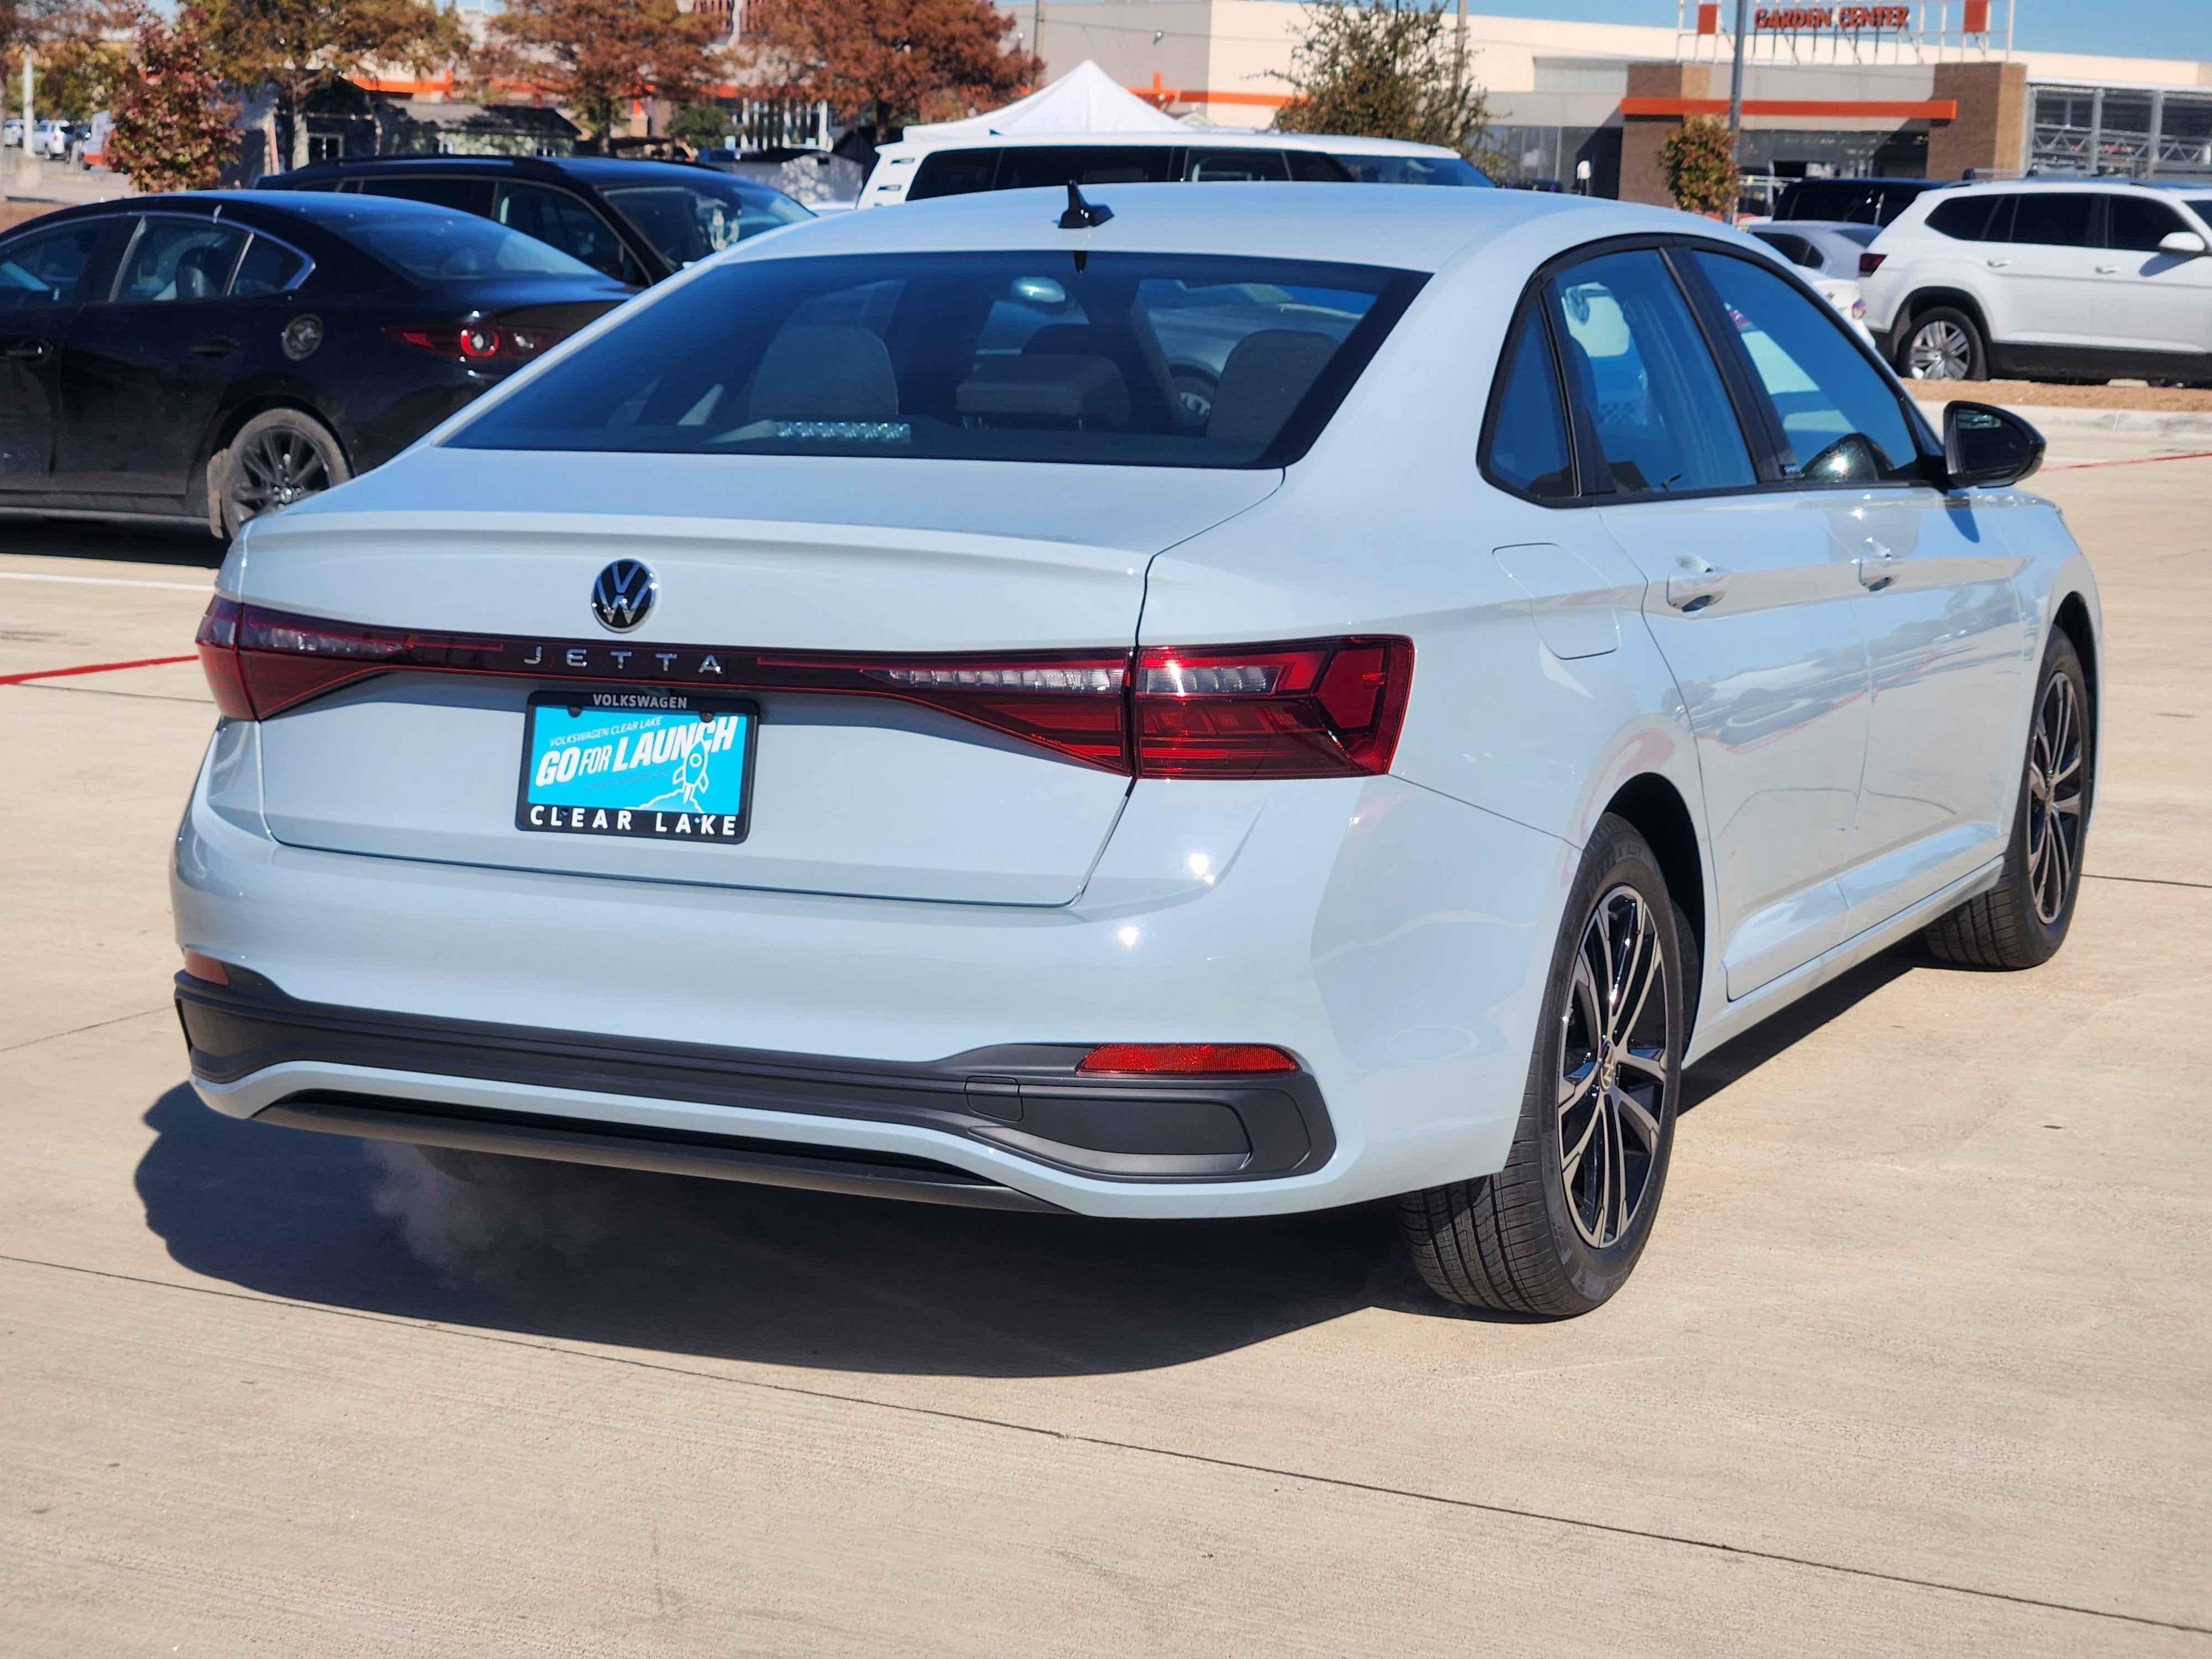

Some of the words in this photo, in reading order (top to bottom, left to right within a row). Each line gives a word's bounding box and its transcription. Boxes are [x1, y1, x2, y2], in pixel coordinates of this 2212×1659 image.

[1754, 7, 1832, 29] GARDEN
[1838, 6, 1911, 28] CENTER
[524, 646, 722, 674] JETTA
[593, 693, 687, 709] VOLKSWAGEN
[550, 727, 609, 747] VOLKSWAGEN
[611, 721, 639, 735] CLEAR
[639, 716, 662, 729] LAKE
[535, 749, 581, 787] GO
[578, 745, 612, 776] FOR
[613, 716, 738, 772] LAUNCH
[530, 806, 632, 830] CLEAR
[655, 812, 737, 836] LAKE
